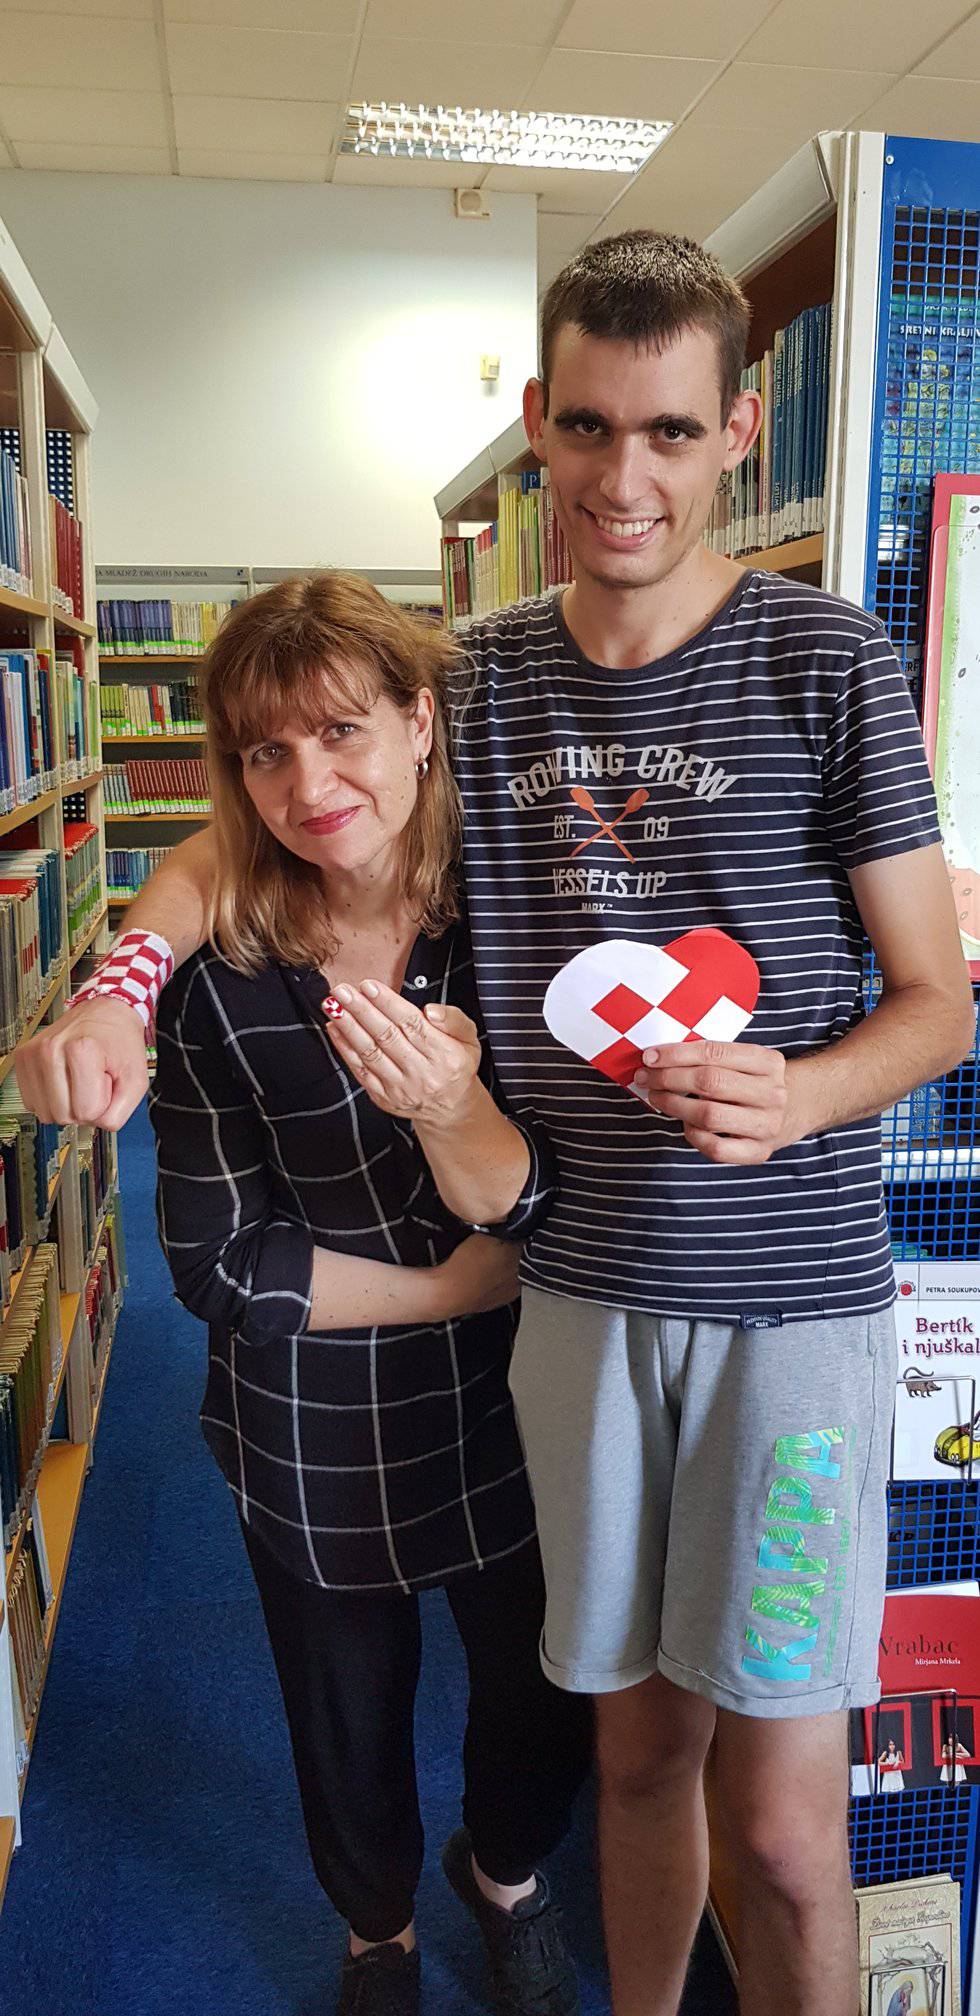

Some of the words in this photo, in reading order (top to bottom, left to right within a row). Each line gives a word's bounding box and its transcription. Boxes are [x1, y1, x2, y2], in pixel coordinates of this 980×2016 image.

[900, 325, 936, 335] SRETNI
[507, 743, 626, 812] ROWING
[636, 744, 739, 803] CREW
[553, 815, 576, 839] EST.
[643, 816, 669, 842] 09
[552, 868, 630, 898] VESSELS
[635, 871, 667, 899] UP
[915, 1316, 973, 1334] Bertík
[902, 1339, 909, 1354] i
[915, 1337, 980, 1358] njuškal
[741, 1425, 844, 1682] KAPPA
[880, 1634, 957, 1656] Vrabac
[915, 1657, 939, 1666] Mirjana
